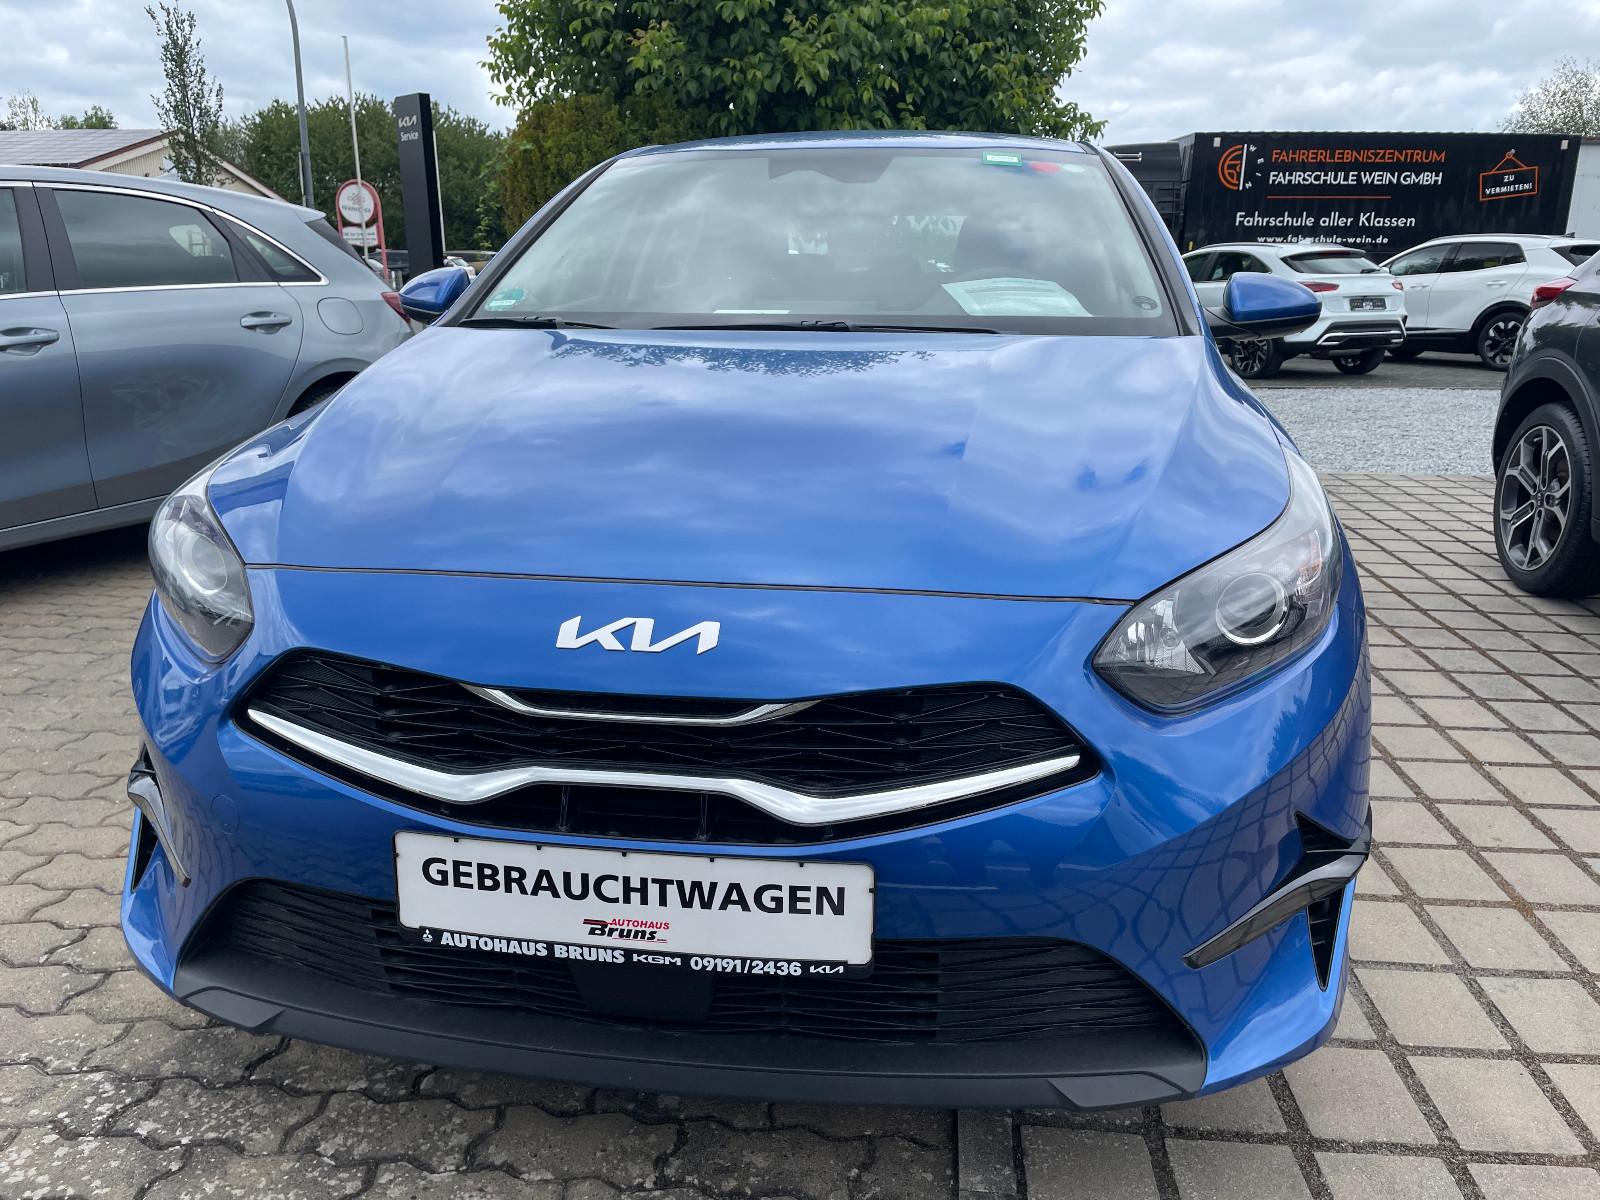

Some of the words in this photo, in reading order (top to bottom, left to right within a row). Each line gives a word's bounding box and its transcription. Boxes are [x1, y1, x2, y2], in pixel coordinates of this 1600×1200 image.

[398, 115, 417, 128] KIA
[400, 131, 419, 142] Service
[1271, 149, 1446, 163] FAHRERLEBNISZENTRUM
[1268, 171, 1358, 185] FAHRSCHULE
[1361, 171, 1398, 185] WEIN
[1400, 171, 1443, 185] GMBH
[1503, 174, 1515, 182] ZU
[1485, 182, 1533, 195] VERMIETEN!
[1235, 211, 1315, 227] Fahrschule
[1319, 211, 1354, 227] aller
[1358, 211, 1416, 227] Klassen
[1257, 234, 1389, 244] www.fahchule-wein.de
[556, 615, 720, 655] KIA
[422, 857, 845, 915] GEBRAUCHTWAGEN
[583, 919, 658, 941] Bruns
[609, 918, 670, 930] AUTOHAUS
[440, 931, 548, 956] AUTOHAUS
[554, 944, 625, 963] BRUNS
[632, 953, 682, 966] KGM
[690, 956, 802, 976] 09191/2436
[809, 964, 844, 975] KIA
